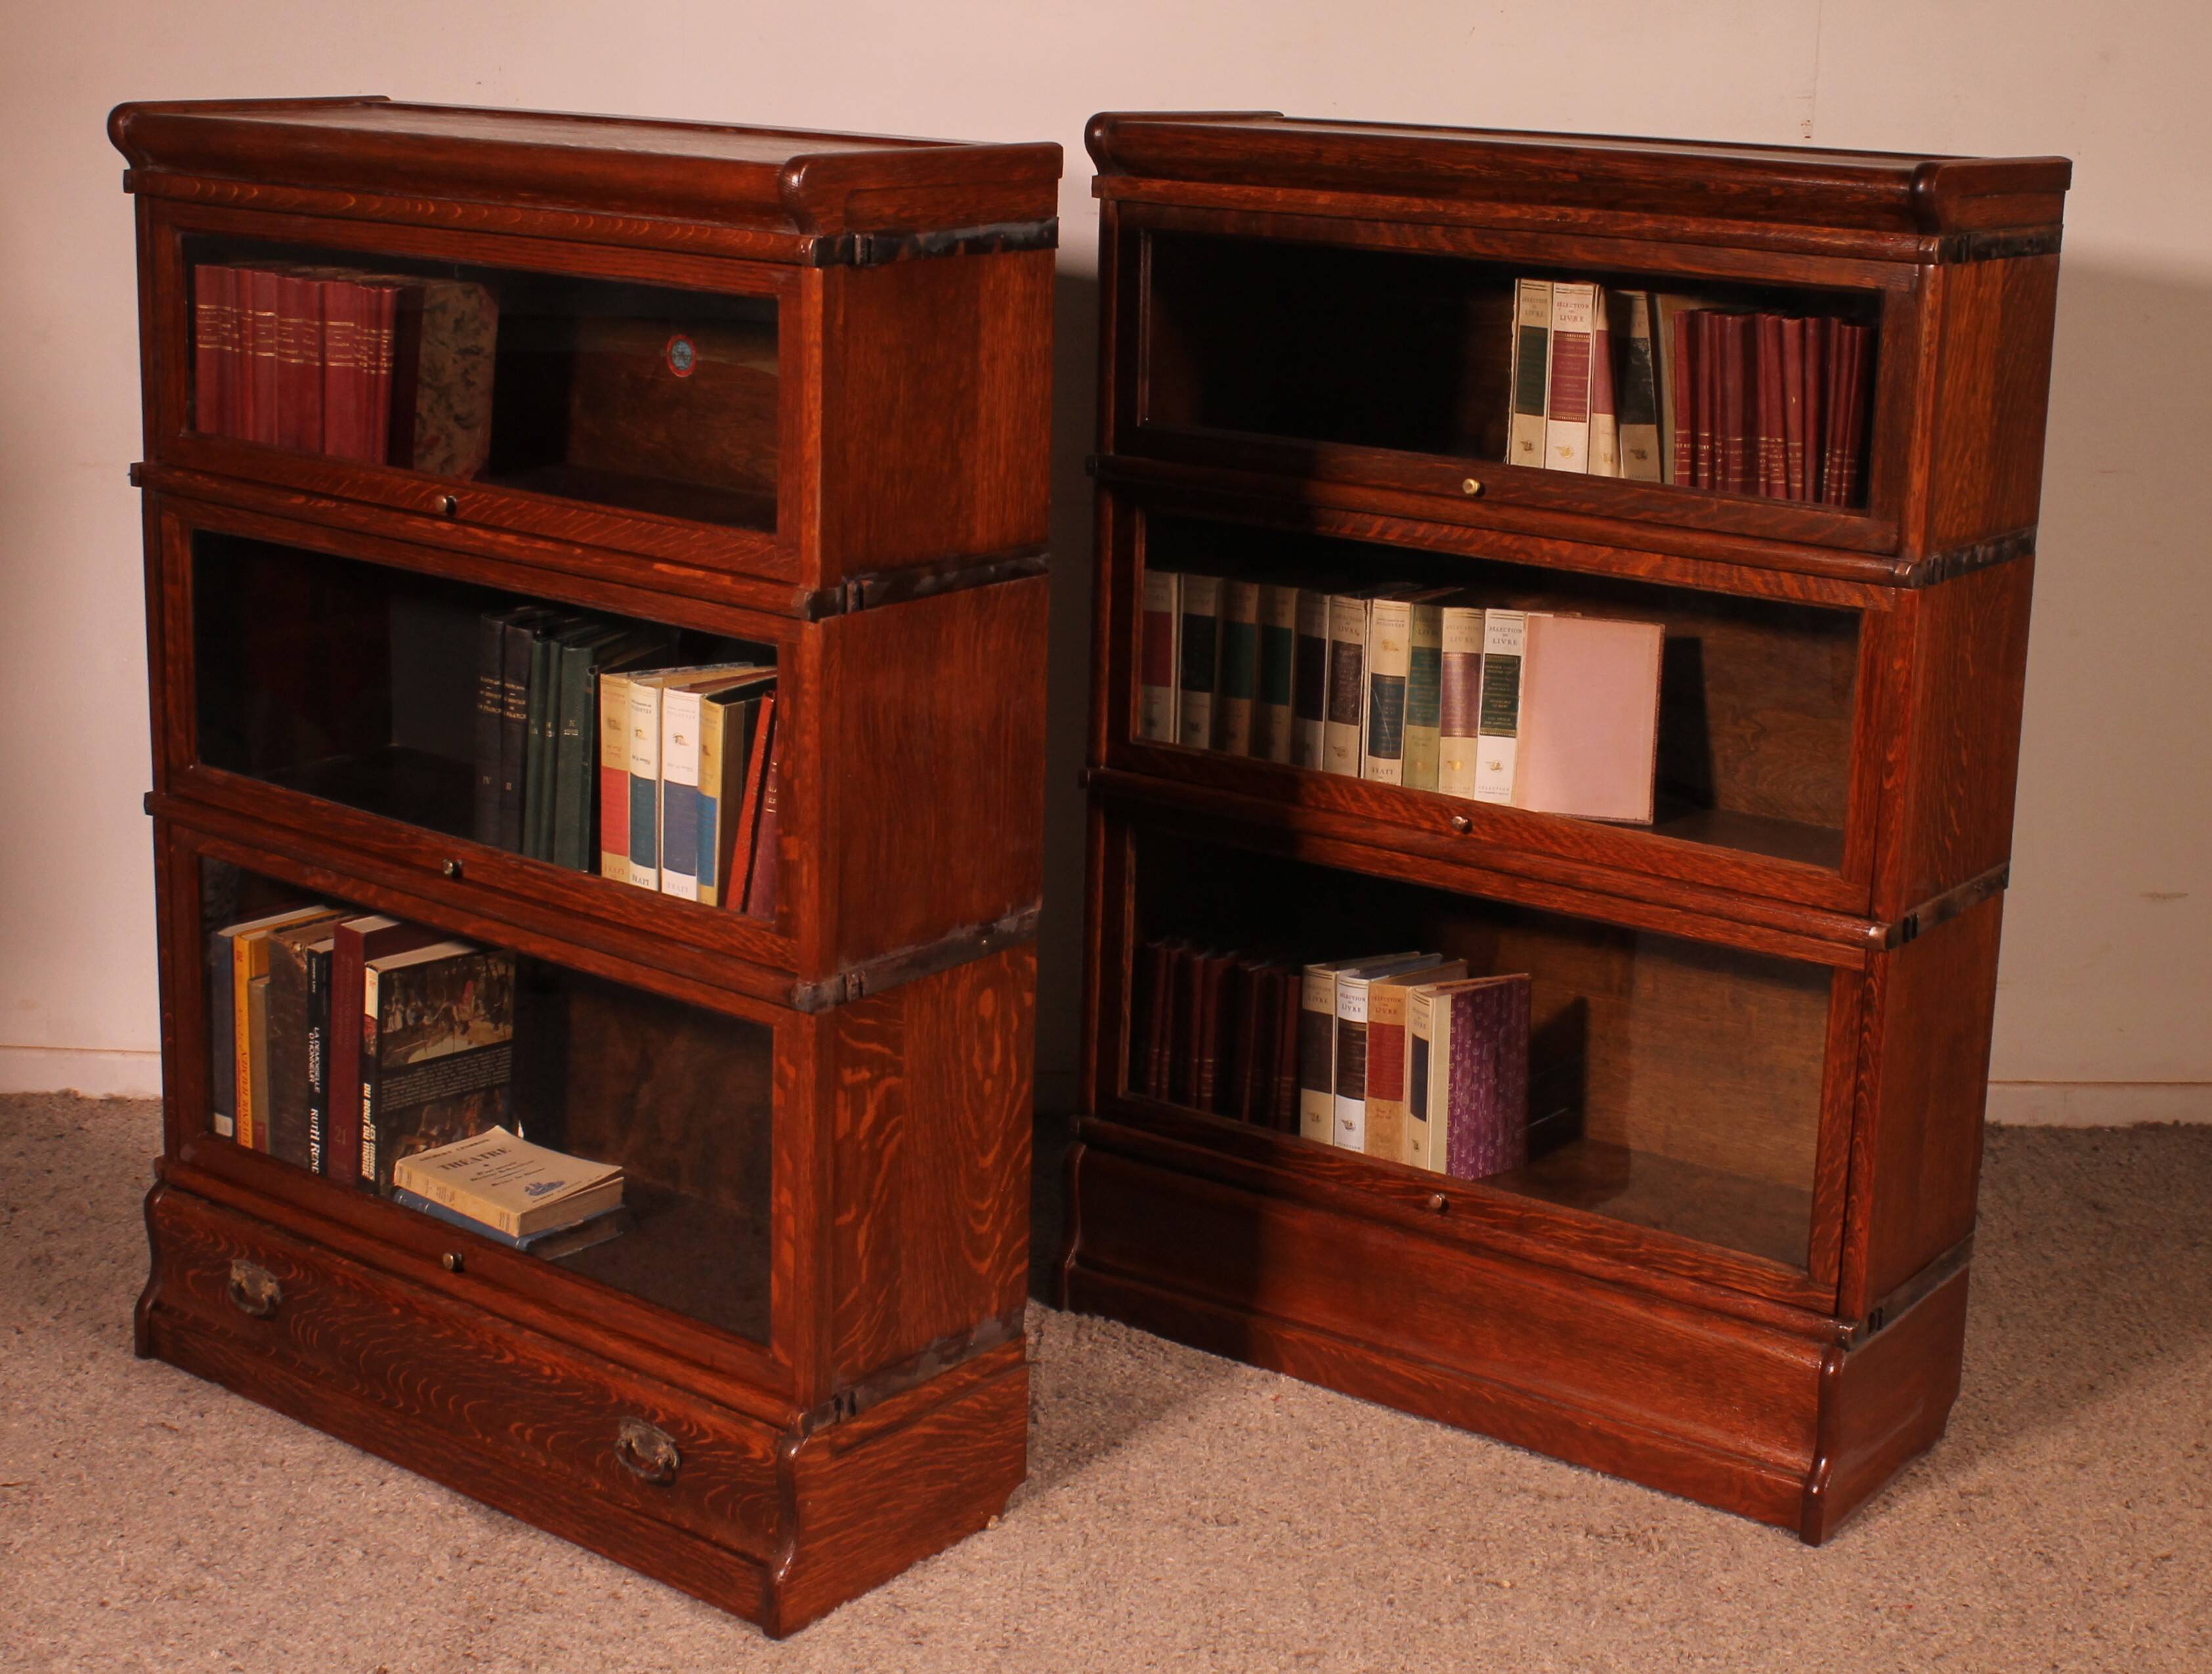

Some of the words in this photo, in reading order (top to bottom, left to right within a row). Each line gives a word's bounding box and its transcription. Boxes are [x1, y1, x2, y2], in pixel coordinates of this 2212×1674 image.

[1449, 635, 1475, 644] LIVRE
[1492, 637, 1518, 646] LIVRE
[1342, 1004, 1362, 1014] LIVRE
[1375, 1006, 1397, 1015] LIVRE
[314, 1026, 320, 1038] LA
[362, 1081, 372, 1100] DU
[362, 1098, 372, 1126] BOUT
[309, 1107, 320, 1142] RUTH
[335, 1125, 347, 1146] 21
[361, 1125, 371, 1142] DU
[360, 1140, 370, 1179] MONDE
